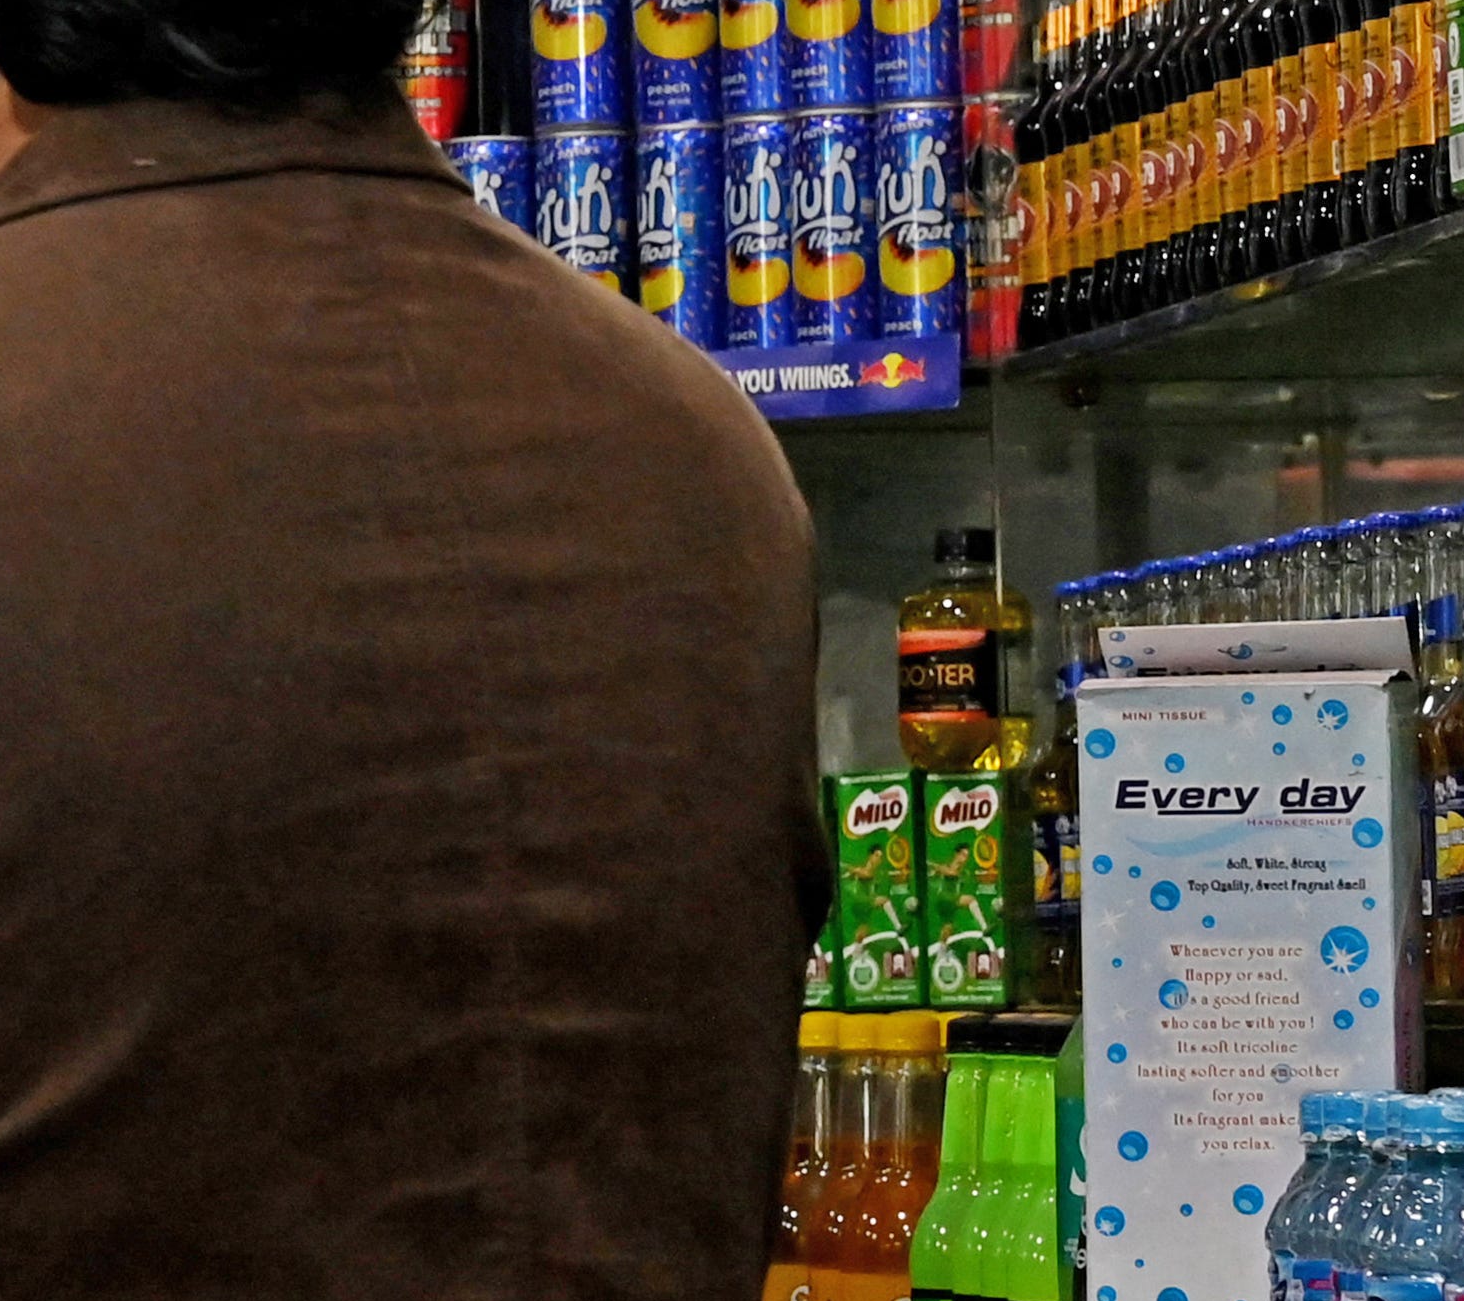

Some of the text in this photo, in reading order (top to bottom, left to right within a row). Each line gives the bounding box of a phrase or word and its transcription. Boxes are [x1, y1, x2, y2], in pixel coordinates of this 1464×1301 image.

[737, 368, 775, 394] YOU
[1122, 710, 1207, 721] MINI TISSUE
[1115, 778, 1366, 815] Every day
[853, 799, 903, 828] MILO
[940, 799, 993, 826] MILO
[1170, 944, 1244, 958] Whenever
[1185, 968, 1232, 985] Happy
[1213, 991, 1300, 1010] good friend
[1161, 1015, 1275, 1030] who with
[1138, 1064, 1266, 1082] lasting softer and
[1197, 1113, 1254, 1130] fragrant
[1233, 1138, 1275, 1151] relax.
